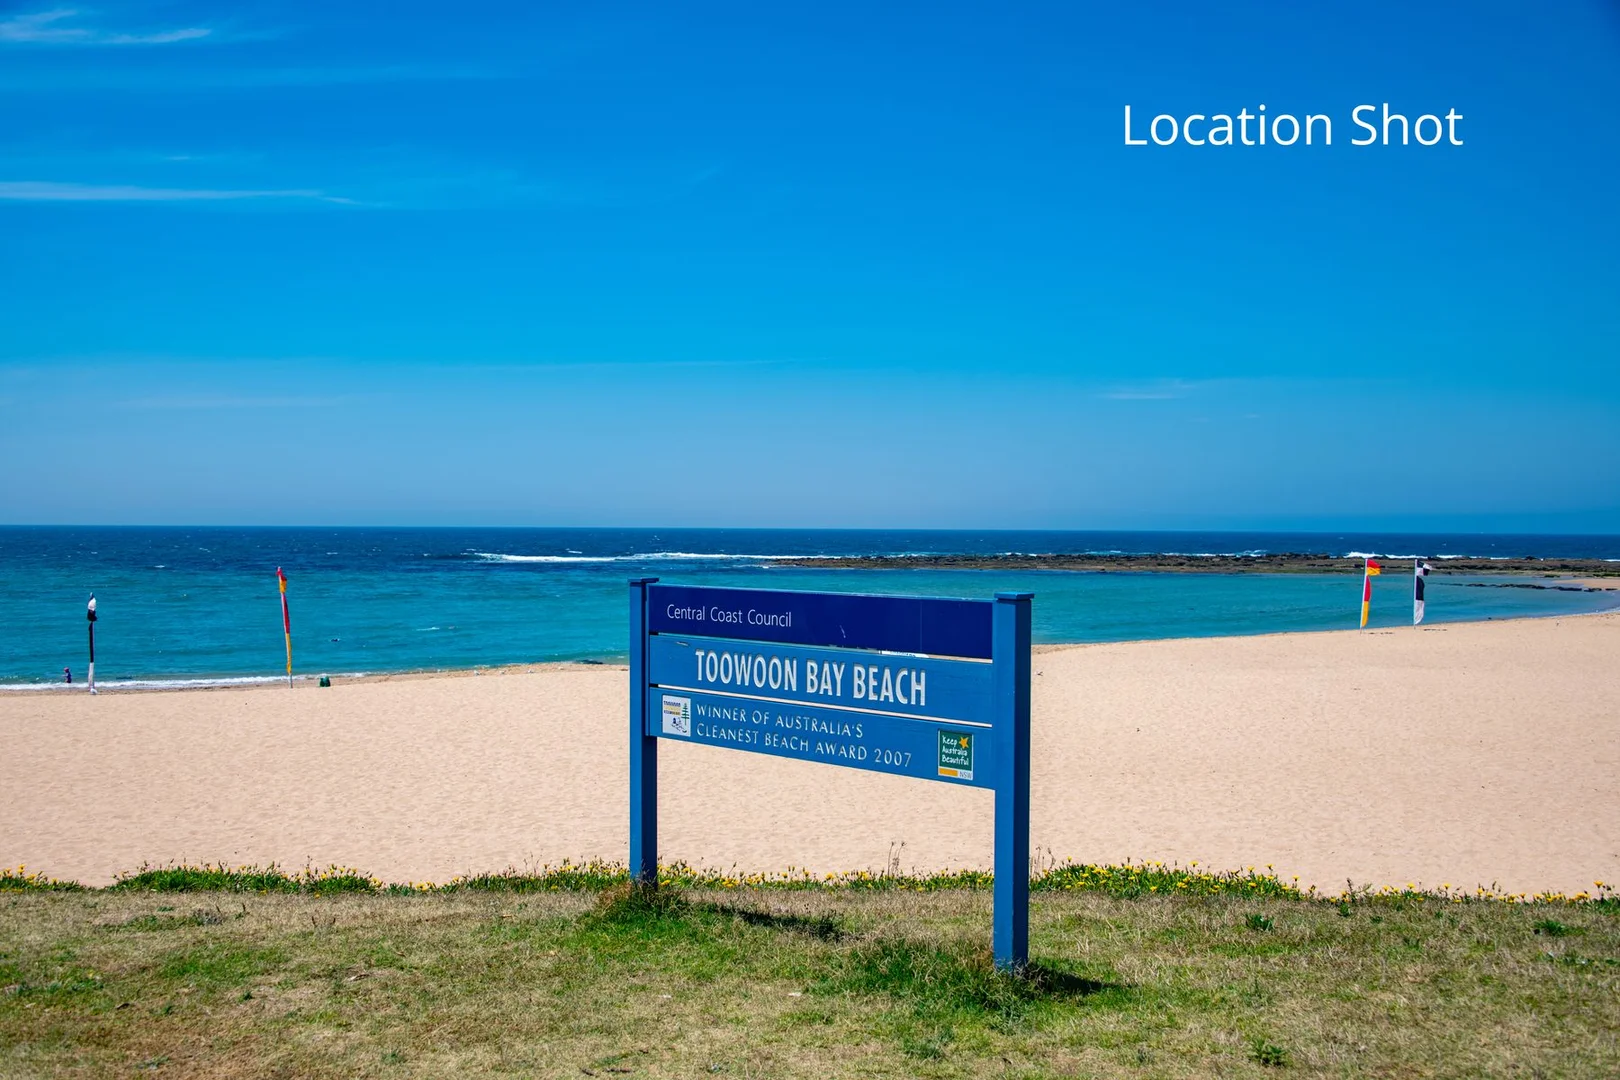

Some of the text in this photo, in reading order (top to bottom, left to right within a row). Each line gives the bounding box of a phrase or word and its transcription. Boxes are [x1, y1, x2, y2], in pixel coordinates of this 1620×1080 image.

[666, 603, 792, 627] Central Coast Council
[695, 649, 926, 706] TOOWOON BAY BEACH
[697, 704, 747, 722] WINNER
[751, 711, 770, 725] OF
[775, 715, 863, 738] AUSTRALIA'S
[696, 723, 912, 767] CLEANEST BEACH AWARD 2007
[942, 735, 958, 747] Keep
[942, 745, 968, 757] Australia
[941, 754, 969, 766] Beautiful
